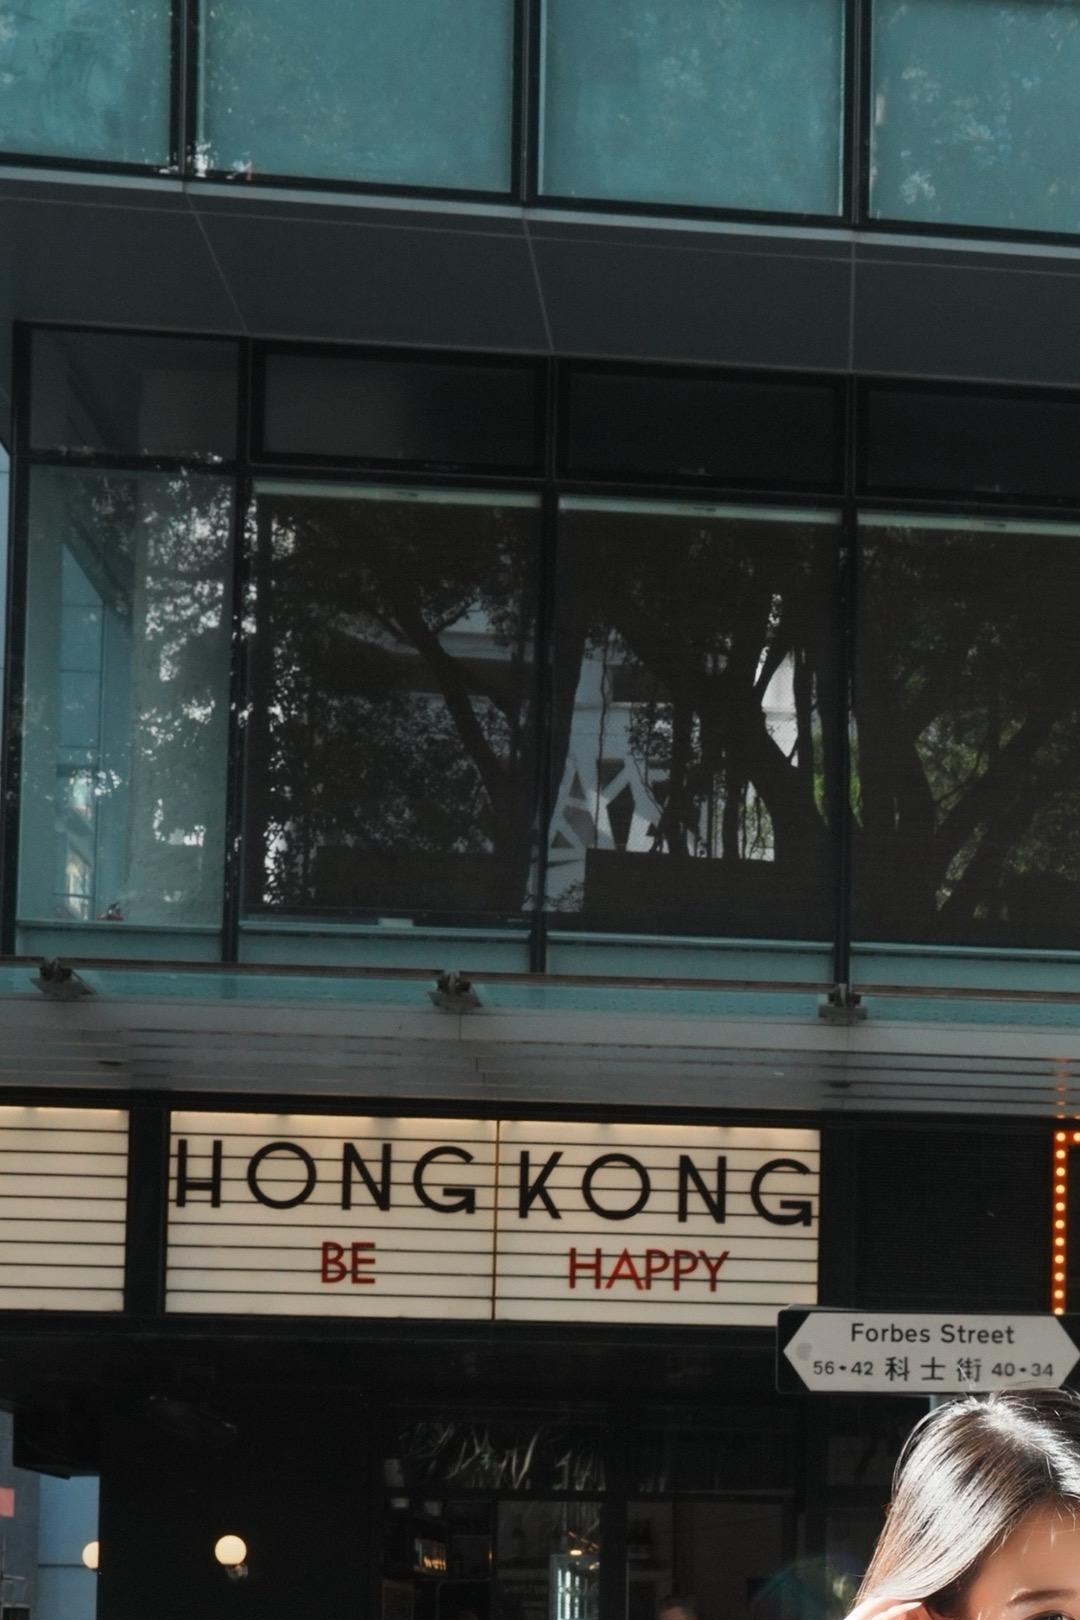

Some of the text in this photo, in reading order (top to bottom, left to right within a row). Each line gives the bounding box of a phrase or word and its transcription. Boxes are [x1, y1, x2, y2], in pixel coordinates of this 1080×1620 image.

[175, 1138, 814, 1226] HONG KONG
[319, 1240, 730, 1293] BE HAPPY
[851, 1322, 1015, 1344] Forbes Street
[885, 1356, 982, 1382] 科士街
